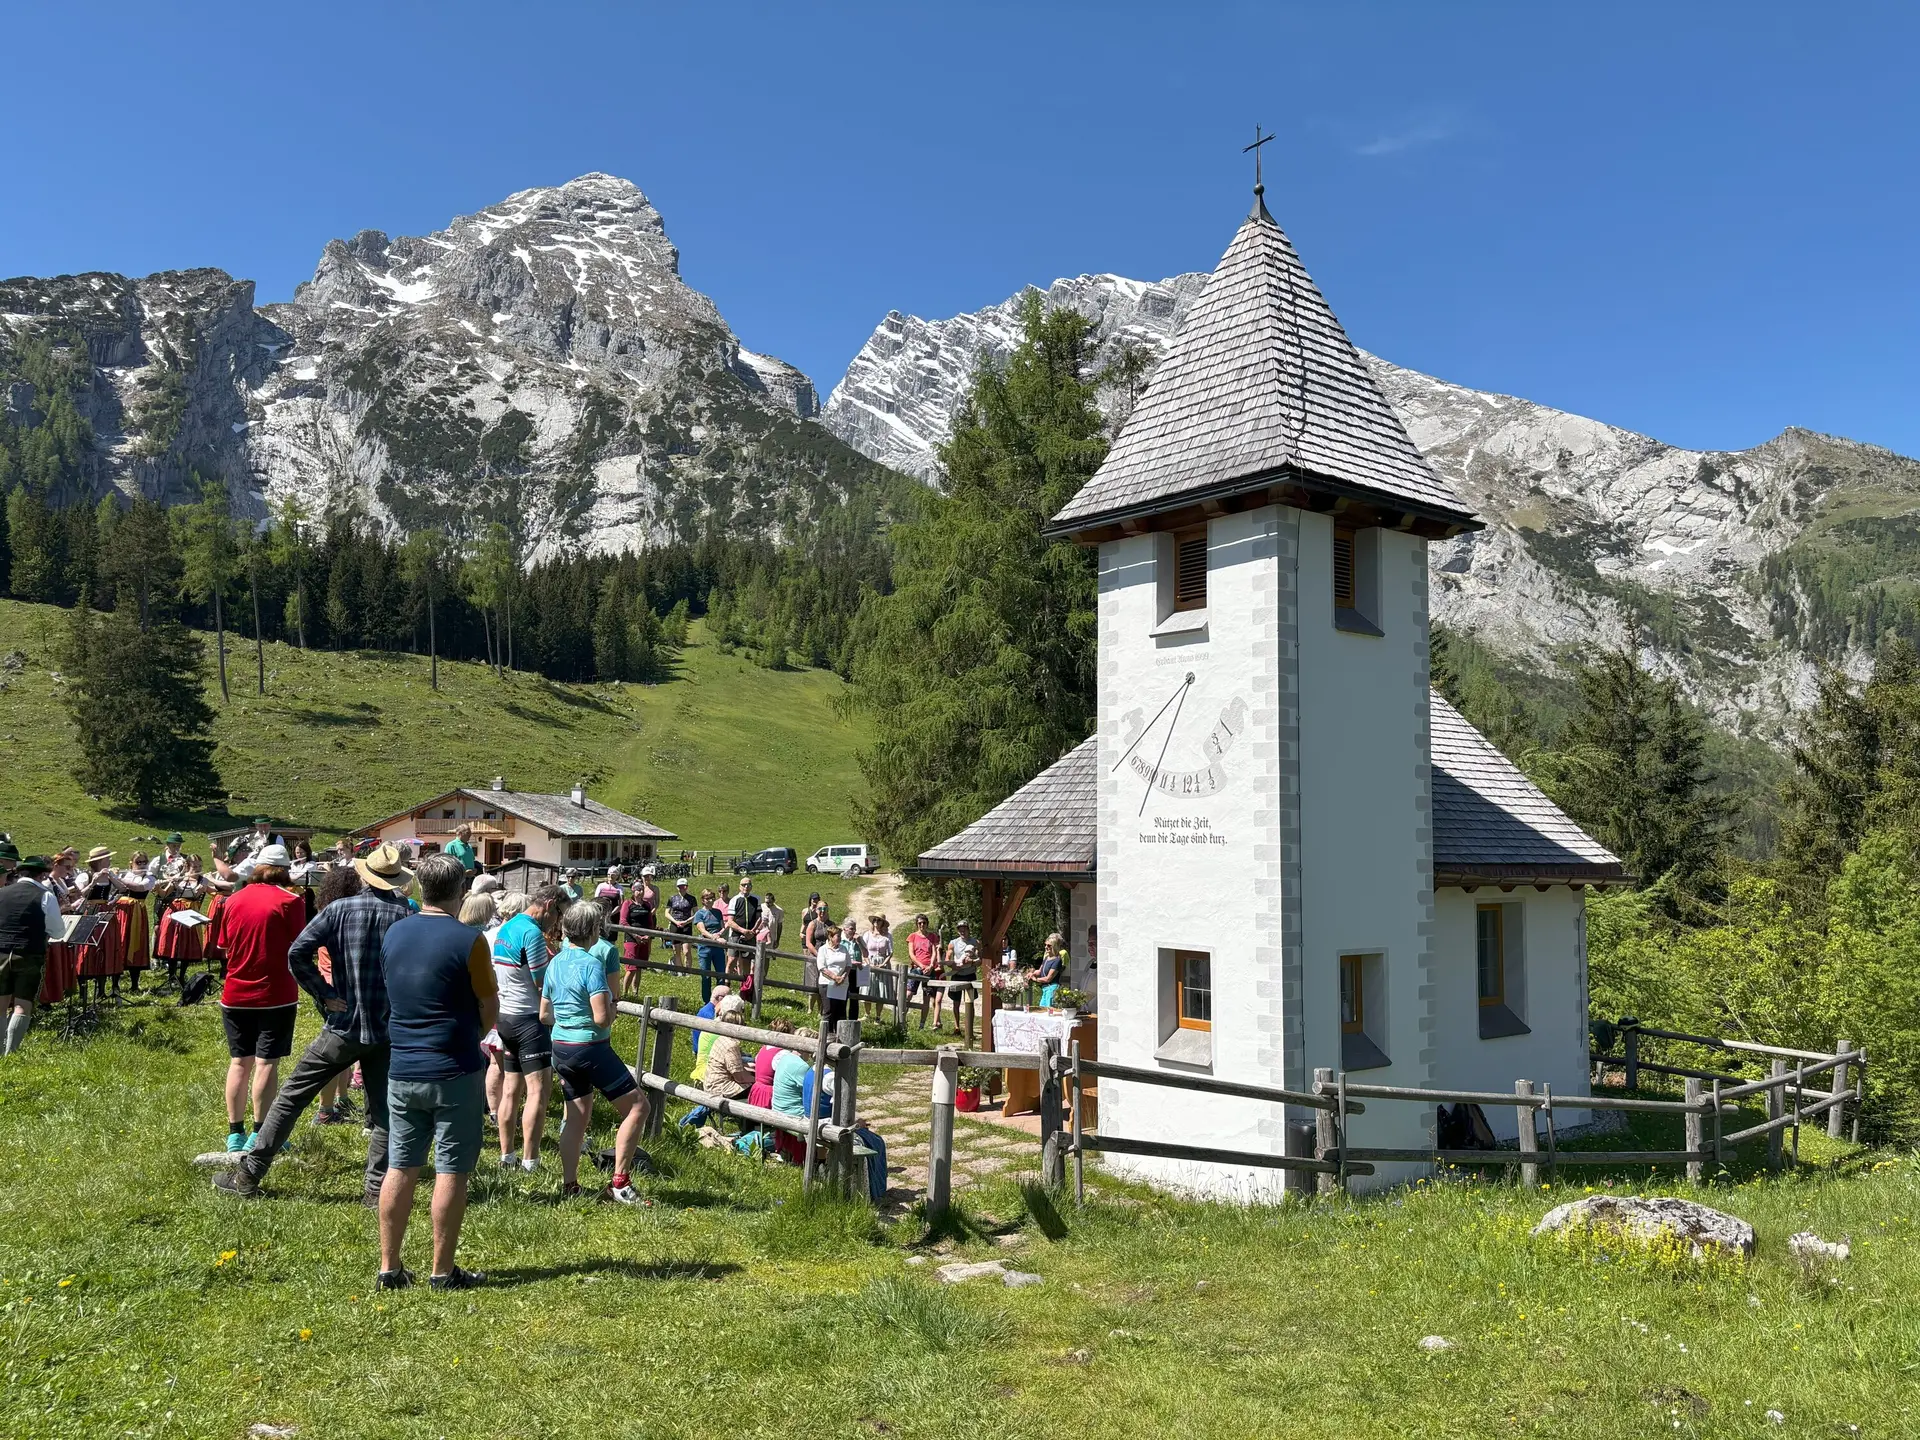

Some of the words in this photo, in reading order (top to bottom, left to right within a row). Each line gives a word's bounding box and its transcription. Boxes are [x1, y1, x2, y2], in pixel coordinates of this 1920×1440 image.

[1183, 774, 1193, 794] 12
[1180, 816, 1192, 828] die
[1193, 816, 1212, 831] Zeit,
[1139, 832, 1156, 844] denn
[1157, 832, 1168, 844] die
[1169, 832, 1189, 846] Tage
[1190, 832, 1208, 844] sind
[1209, 832, 1228, 847] kurz.
